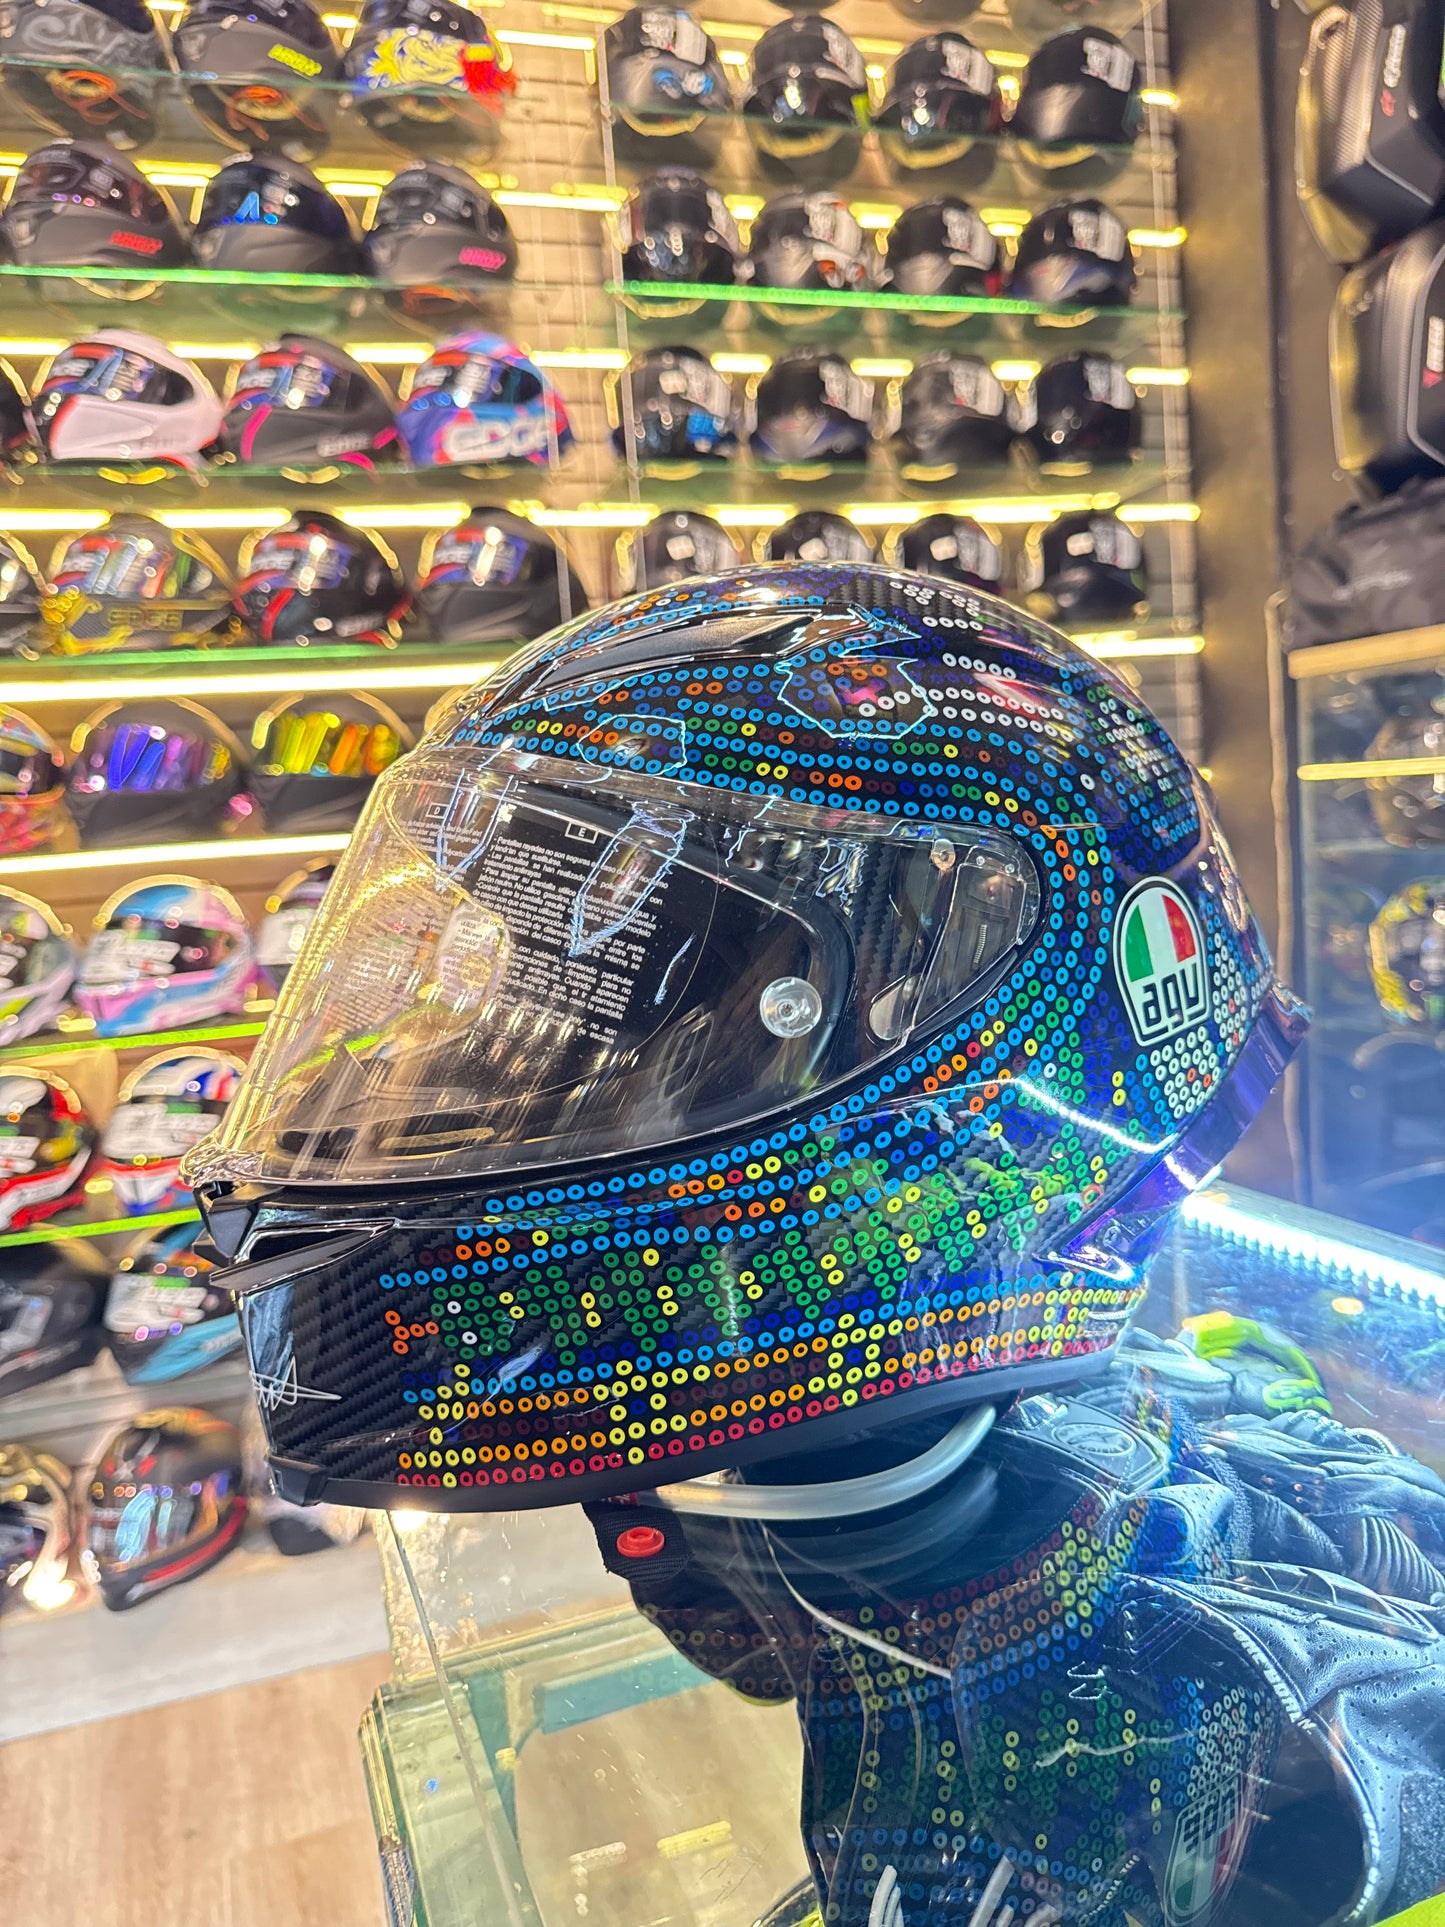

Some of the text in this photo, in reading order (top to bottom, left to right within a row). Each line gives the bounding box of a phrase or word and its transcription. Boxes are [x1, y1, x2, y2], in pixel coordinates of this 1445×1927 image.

[578, 827, 586, 837] E
[578, 892, 629, 912] clusivamente
[651, 914, 656, 922] y
[649, 896, 663, 905] con
[531, 931, 541, 939] del
[541, 935, 561, 945] casco
[625, 924, 651, 937] modelo
[543, 925, 573, 940] diferente
[608, 945, 626, 956] entre
[631, 952, 642, 962] los
[613, 939, 625, 948] por
[626, 942, 646, 954] parte
[518, 945, 530, 953] con
[565, 959, 597, 975] poniendo
[601, 971, 634, 986] particular
[552, 964, 562, 972] de
[601, 979, 618, 991] para
[552, 983, 566, 993] que
[563, 976, 592, 991] Cuando
[595, 987, 629, 1003] aparecen
[537, 986, 548, 994] En
[587, 1002, 594, 1010] la
[1142, 962, 1200, 1030] agv
[589, 1022, 599, 1030] no
[603, 1027, 617, 1036] son
[589, 1031, 614, 1044] escasa
